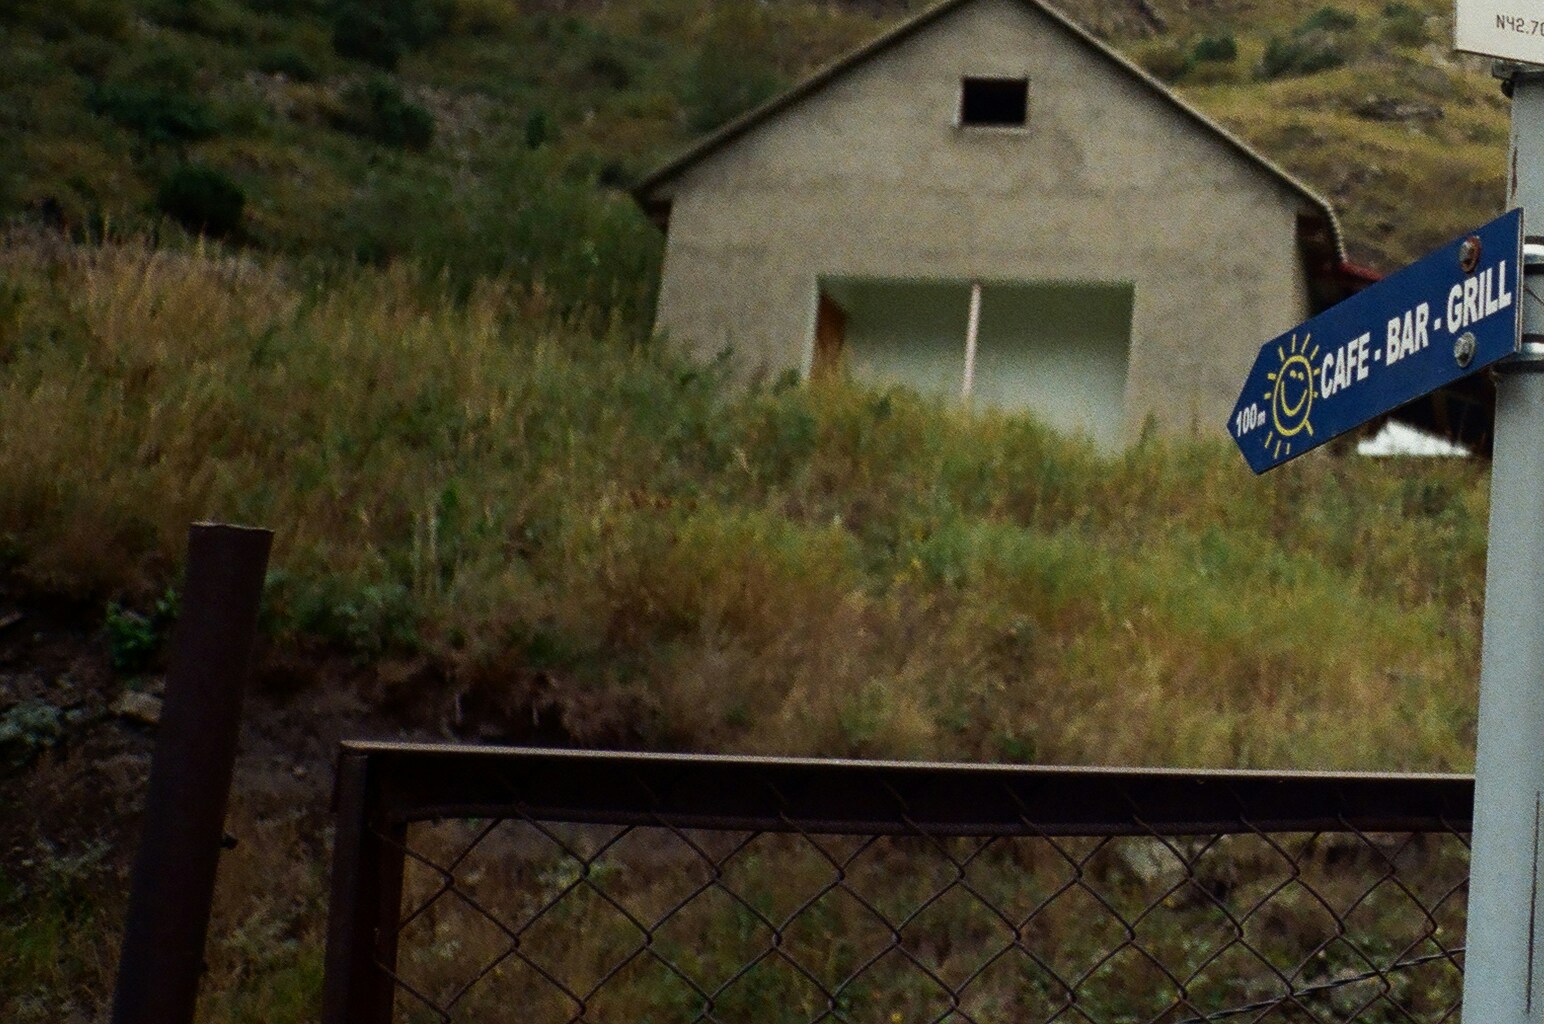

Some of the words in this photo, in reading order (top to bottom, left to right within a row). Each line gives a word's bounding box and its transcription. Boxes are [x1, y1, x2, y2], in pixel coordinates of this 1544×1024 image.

[1321, 332, 1370, 400] CAFE
[1386, 302, 1429, 366] BAR
[1447, 260, 1511, 333] GRILL
[1236, 403, 1266, 437] 100m
